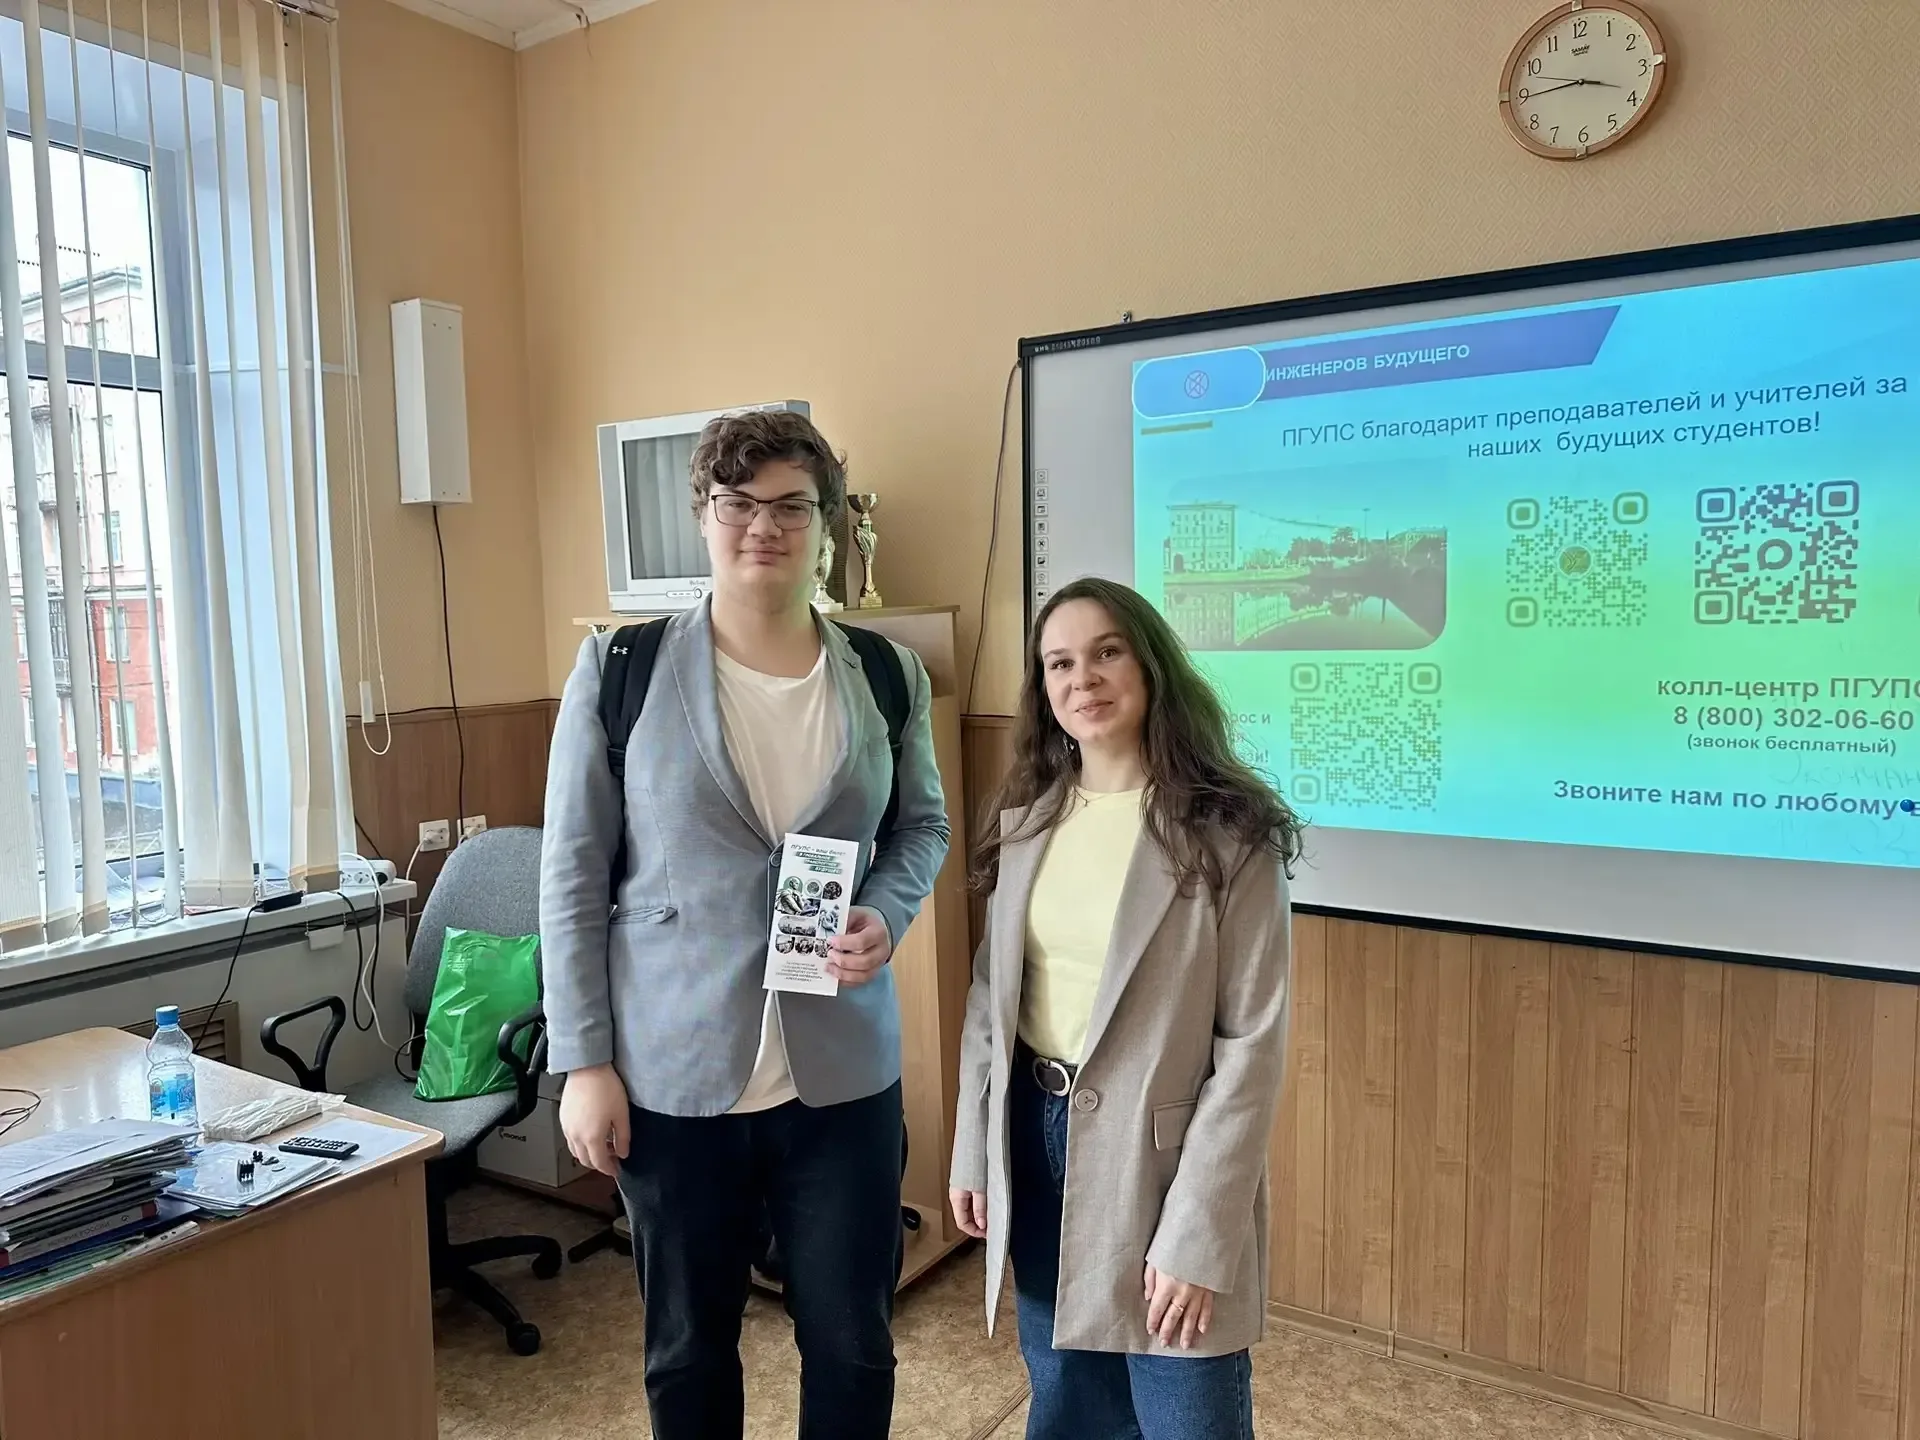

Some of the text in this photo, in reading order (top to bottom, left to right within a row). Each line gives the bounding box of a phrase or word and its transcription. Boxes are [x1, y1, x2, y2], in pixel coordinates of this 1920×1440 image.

[1572, 20, 1588, 39] 12
[1606, 20, 1611, 37] 1
[1547, 35, 1558, 53] 11
[1625, 33, 1636, 51] 2
[1527, 58, 1542, 76] 10
[1637, 58, 1648, 76] 3
[1518, 88, 1530, 105] 9
[1626, 90, 1637, 107] 4
[1529, 114, 1540, 130] 8
[1607, 113, 1617, 132] 5
[1550, 126, 1559, 143] 7
[1577, 125, 1589, 143] 6
[1266, 344, 1471, 382] ИНЖЕНЕРОВ БУДУЩЕГО
[1282, 375, 1907, 448] ПГУПС благодарит преподавателей и учителей за
[1468, 411, 1821, 458] наших будущих студентов!
[1657, 680, 1820, 702] колл-центр
[1261, 713, 1271, 725] и
[1673, 706, 1914, 732] 8 (800) 302-06-60
[1687, 734, 1897, 756] (звонок бесплатный)
[1553, 779, 1662, 803] Звоните
[1671, 789, 1722, 807] нам
[1733, 792, 1767, 809] по
[1774, 792, 1900, 821] любому
